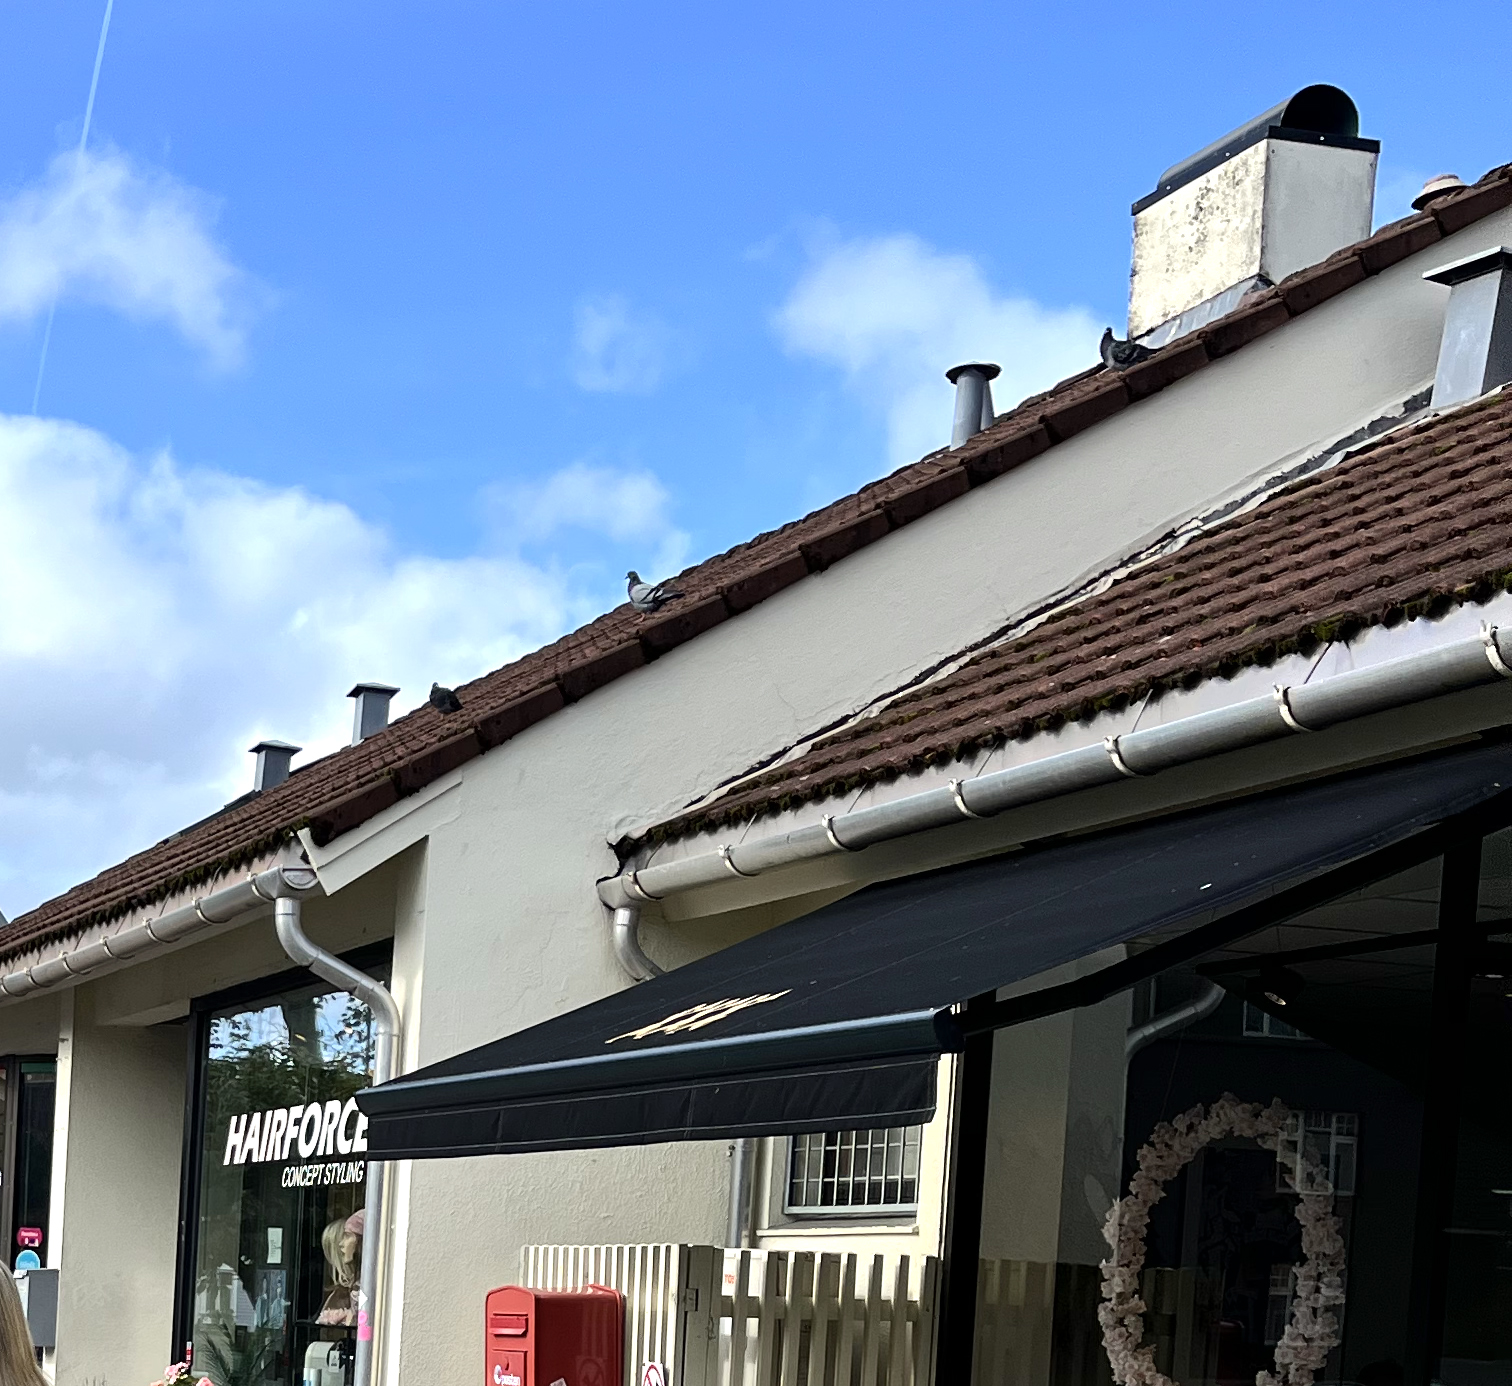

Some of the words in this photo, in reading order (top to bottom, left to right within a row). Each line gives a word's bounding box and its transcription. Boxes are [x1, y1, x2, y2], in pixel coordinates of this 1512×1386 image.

[223, 1096, 369, 1166] HAIRFORCE
[281, 1164, 325, 1188] CONCEPT
[325, 1160, 365, 1185] STYLING
